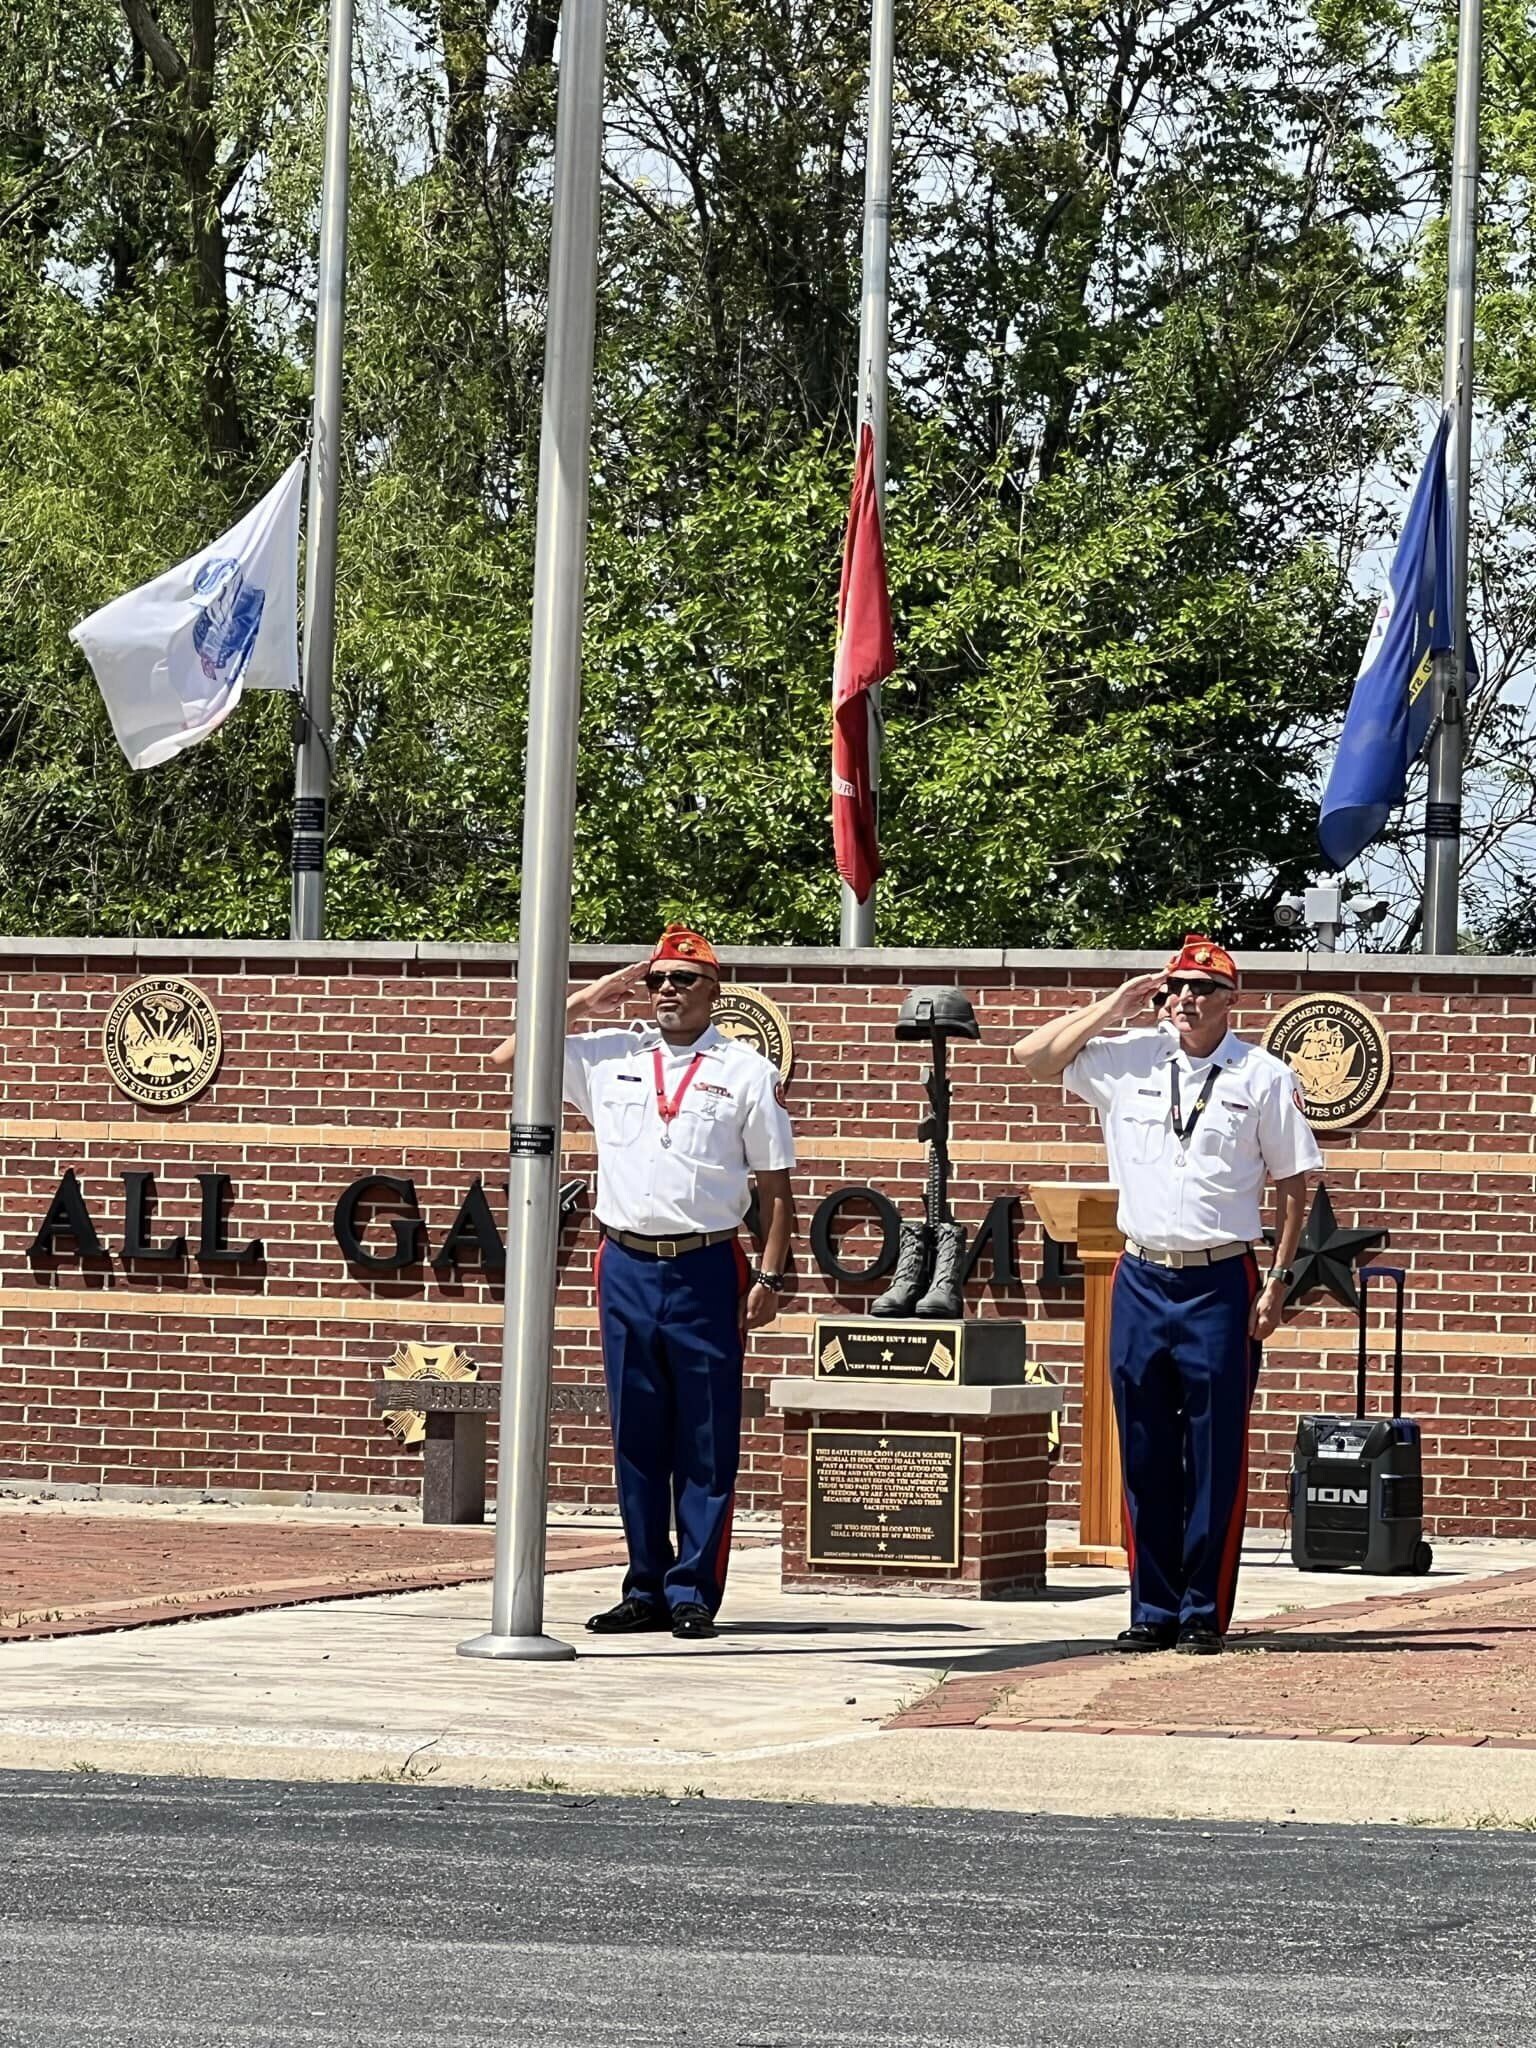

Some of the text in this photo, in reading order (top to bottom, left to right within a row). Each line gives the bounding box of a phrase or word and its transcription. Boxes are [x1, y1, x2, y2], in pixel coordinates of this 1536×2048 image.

[109, 982, 217, 1042] DEPARTMENT OF THE ARMY
[739, 1001, 780, 1055] OF THE NAVY
[1271, 1004, 1378, 1053] DEPARTMENT OF THE NAVY
[107, 1043, 216, 1100] UNITED STATES OF AMERICA
[1302, 1066, 1379, 1118] ATES OF AMERICA
[26, 1167, 265, 1264] ALL
[847, 1334, 928, 1344] FREEDOM ISN'T FREE
[431, 1386, 500, 1408] FREED
[817, 1468, 847, 1476] FREEDOM
[884, 1484, 915, 1492] ULTIMATE
[1307, 1488, 1368, 1504] ION
